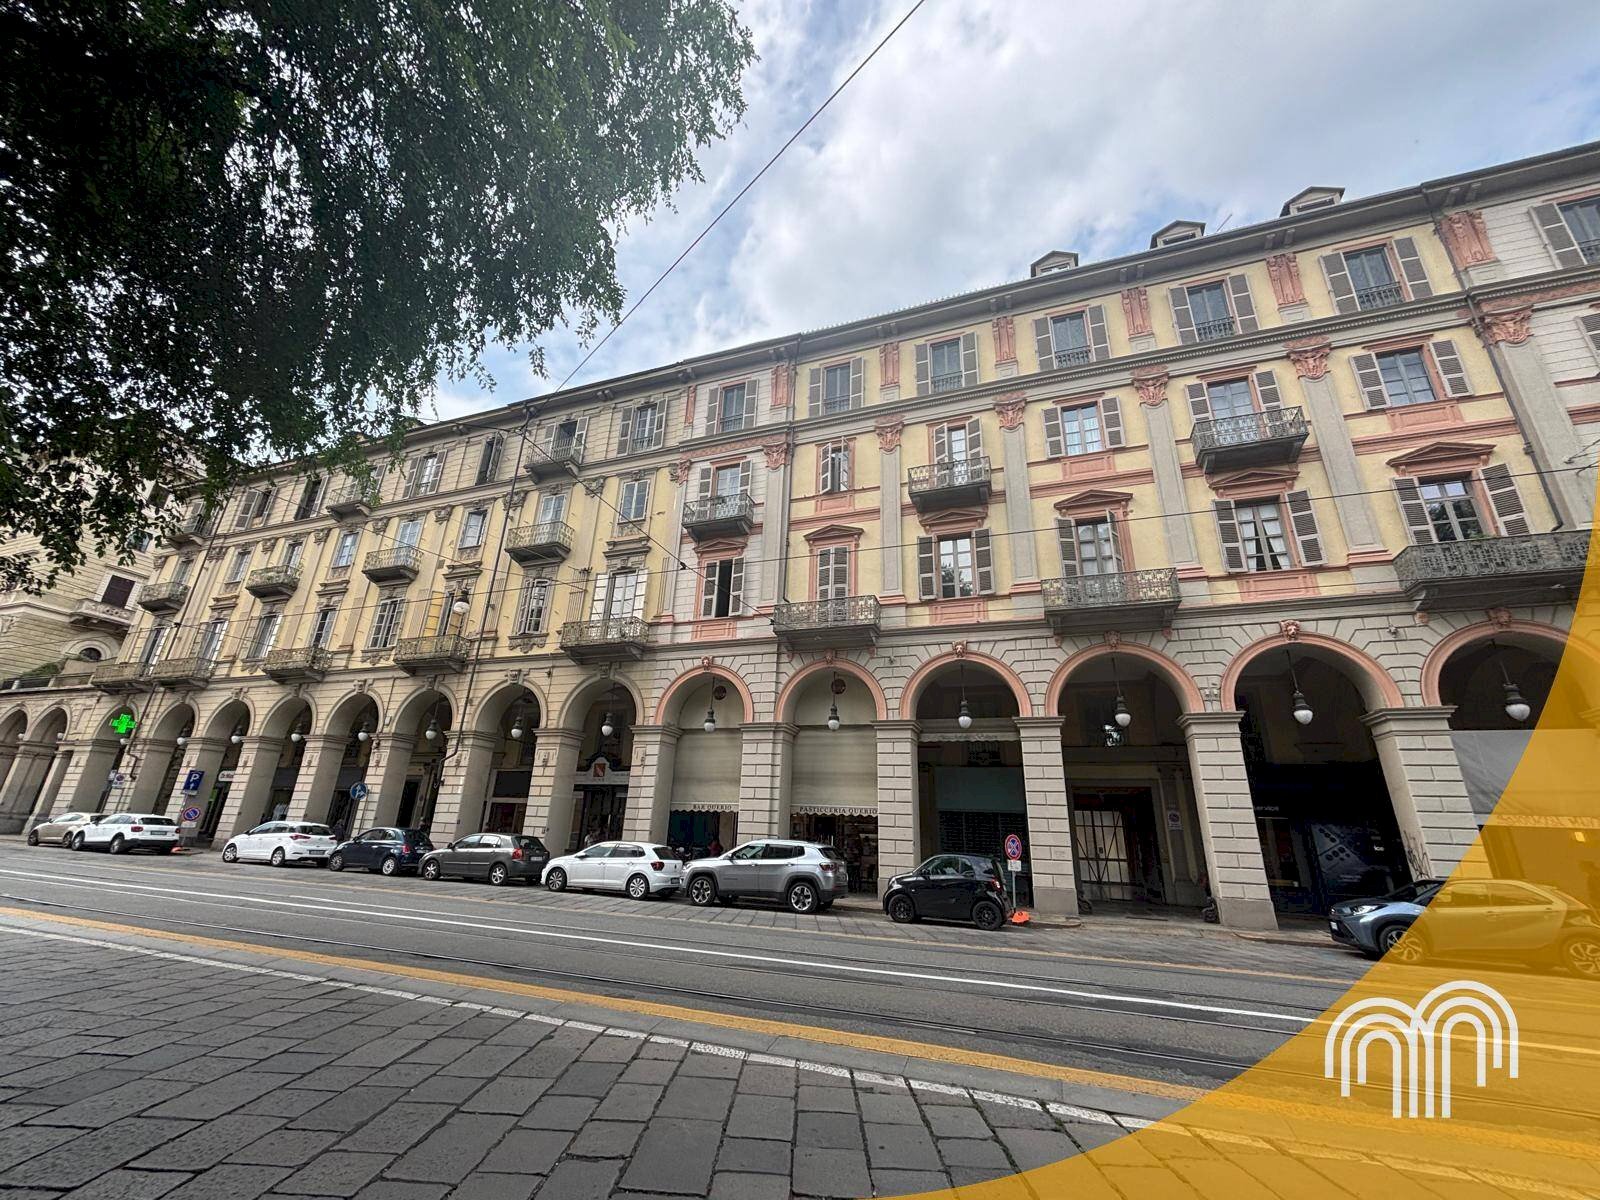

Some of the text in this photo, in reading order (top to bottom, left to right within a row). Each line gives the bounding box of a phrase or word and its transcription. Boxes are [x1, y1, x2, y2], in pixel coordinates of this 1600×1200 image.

[190, 773, 200, 783] P
[693, 803, 705, 811] BAR
[799, 805, 878, 816] PASTICCERIA QUERIO
